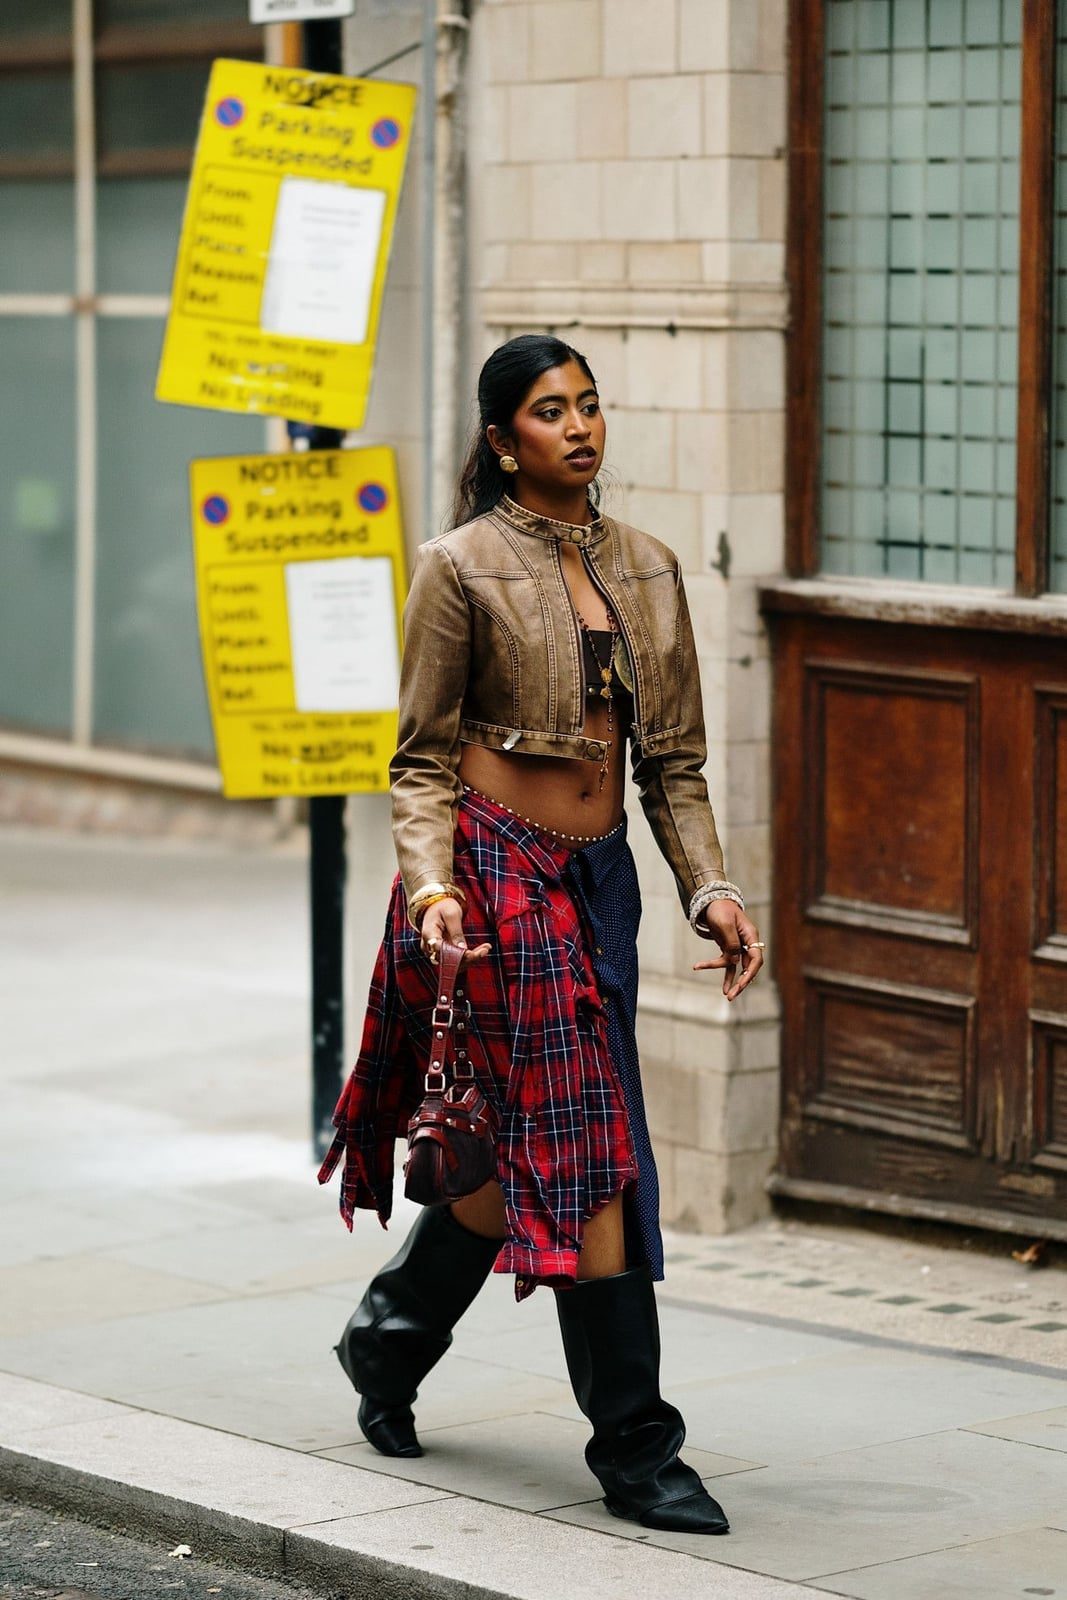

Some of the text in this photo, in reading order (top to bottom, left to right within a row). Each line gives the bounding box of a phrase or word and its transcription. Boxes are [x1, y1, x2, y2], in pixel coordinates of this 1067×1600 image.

[259, 111, 355, 147] Parking
[230, 136, 373, 175] Suspended
[239, 456, 341, 483] NOTICE
[246, 500, 342, 521] Parking
[226, 525, 369, 554] Suspended
